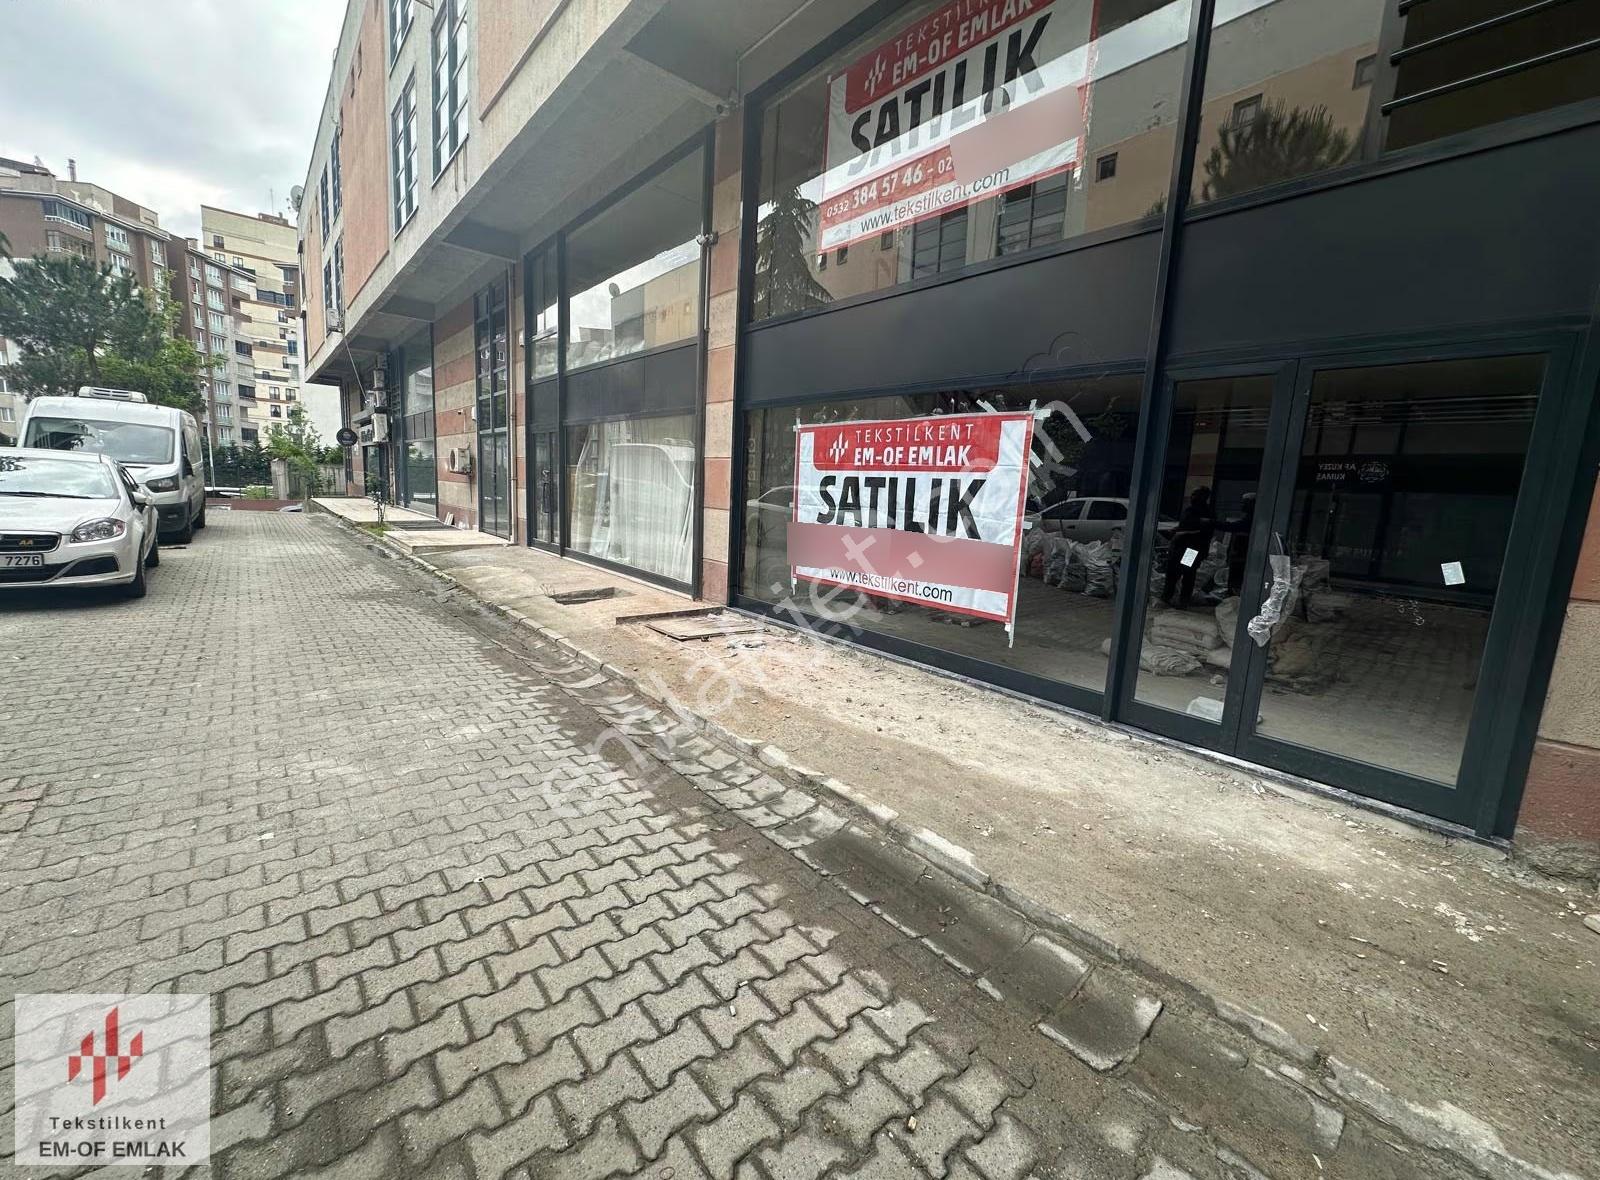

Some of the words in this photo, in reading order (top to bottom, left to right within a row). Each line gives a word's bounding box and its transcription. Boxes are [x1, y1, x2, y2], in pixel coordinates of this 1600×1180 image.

[892, 31, 953, 86] EM-OF
[957, 0, 1033, 48] EMLAK
[847, 12, 1053, 176] SATILIK
[826, 200, 849, 218] 0532
[852, 181, 878, 209] 384
[881, 173, 898, 197] 57
[901, 163, 923, 187] 46
[860, 167, 1010, 233] www.tekstilkent.com
[853, 447, 904, 467] EM-OF
[908, 444, 971, 467] EMLAK
[855, 423, 974, 444] TEKSTİLKENT
[816, 475, 987, 541] SATILIK
[5, 556, 40, 566] 7276
[830, 568, 953, 602] www.tekstilkent.com
